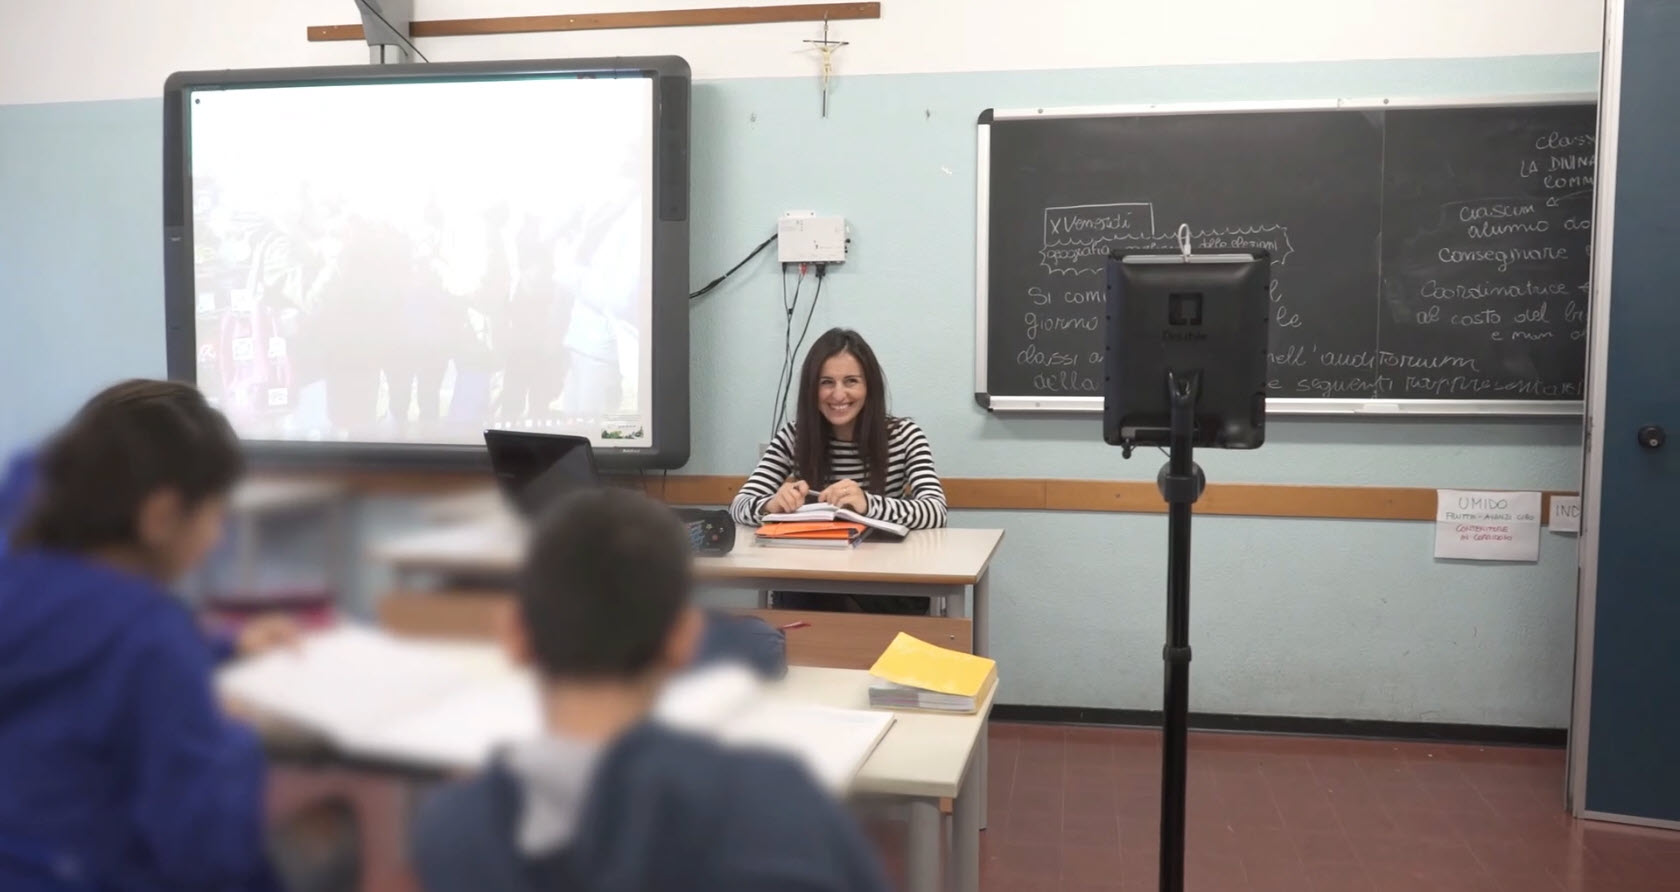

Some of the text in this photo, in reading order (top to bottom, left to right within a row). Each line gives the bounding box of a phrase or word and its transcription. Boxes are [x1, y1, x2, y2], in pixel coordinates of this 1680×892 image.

[1520, 160, 1538, 177] LA
[1451, 309, 1501, 326] costo
[1458, 497, 1508, 510] UMIDO
